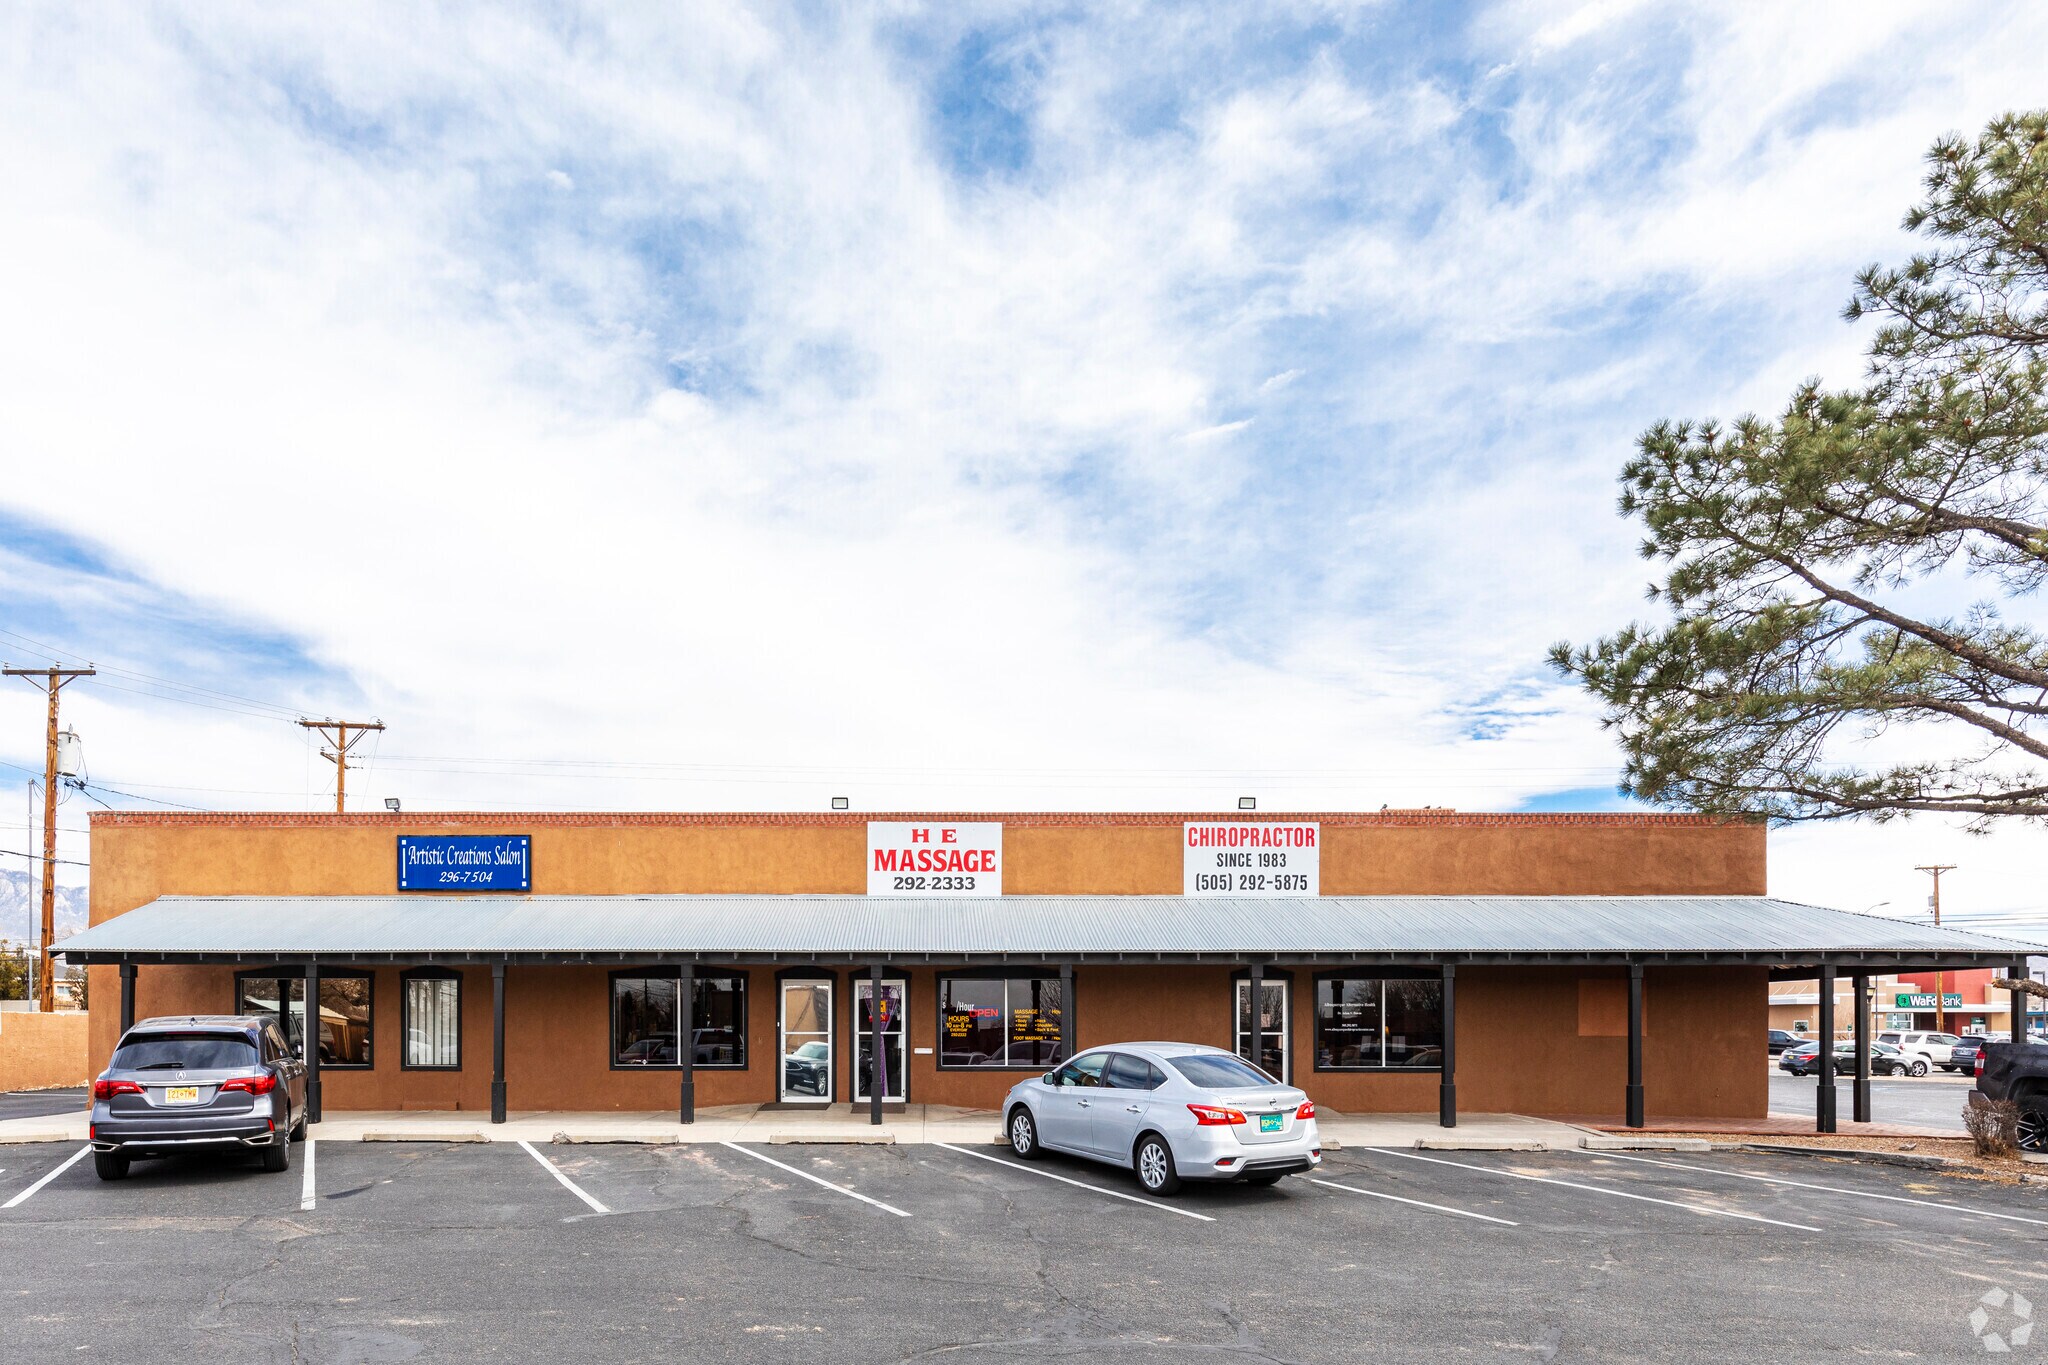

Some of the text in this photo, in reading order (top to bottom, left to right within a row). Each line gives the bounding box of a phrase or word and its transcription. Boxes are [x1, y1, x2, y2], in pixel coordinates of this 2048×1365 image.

[1188, 827, 1315, 847] CHIROPRACTOR
[408, 841, 520, 865] Artistic Creations Salon
[1217, 853, 1287, 867] SINCE 1983
[874, 849, 996, 872] MASSAGE
[439, 871, 493, 883] 296-7504
[893, 876, 976, 890] 292-2333
[1195, 873, 1307, 891] (505) 292-5875
[1910, 996, 1937, 1006] WaFd
[969, 1008, 999, 1018] OPEN
